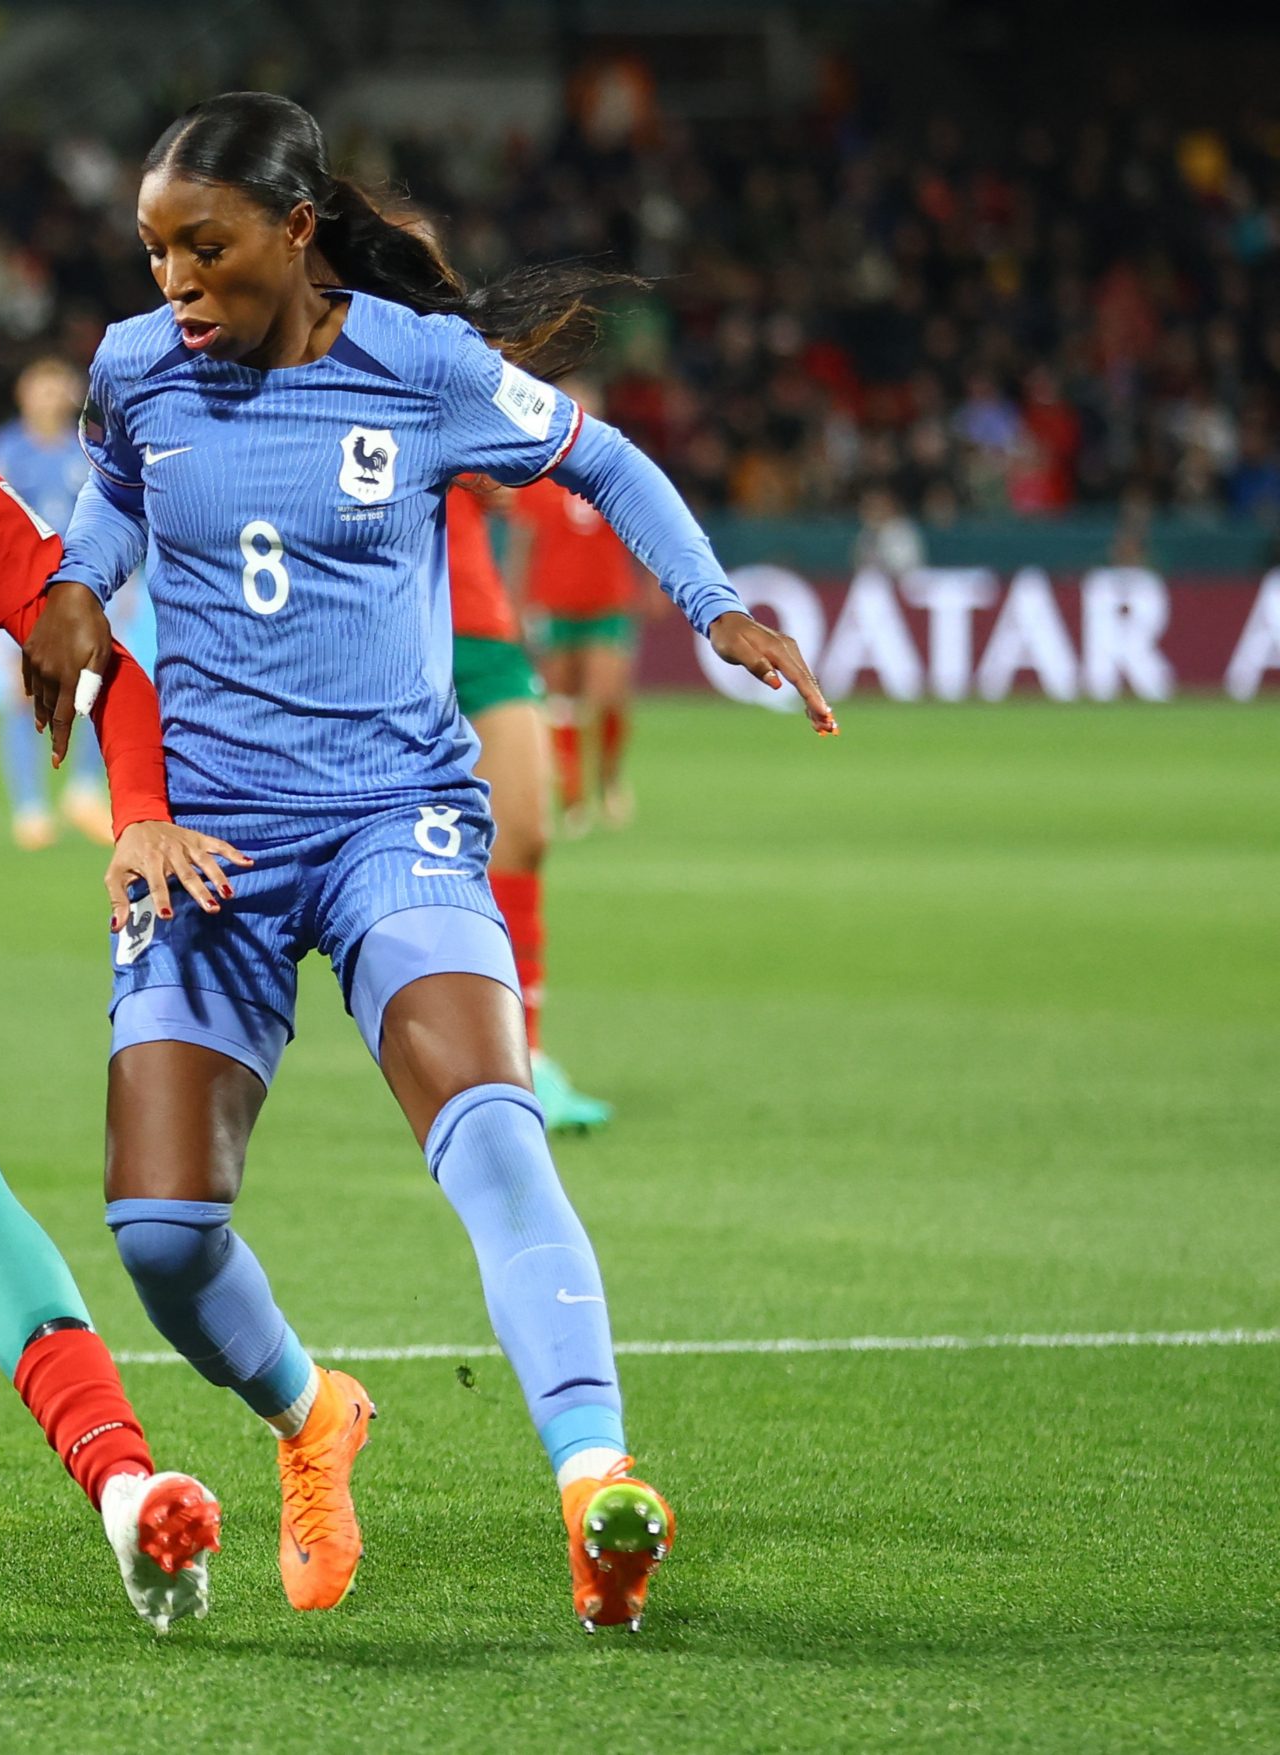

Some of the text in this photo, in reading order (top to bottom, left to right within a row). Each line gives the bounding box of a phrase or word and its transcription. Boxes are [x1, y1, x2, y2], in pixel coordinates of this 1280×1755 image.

[239, 520, 290, 615] 8
[694, 565, 1176, 712] QATAR
[413, 805, 462, 858] 8
